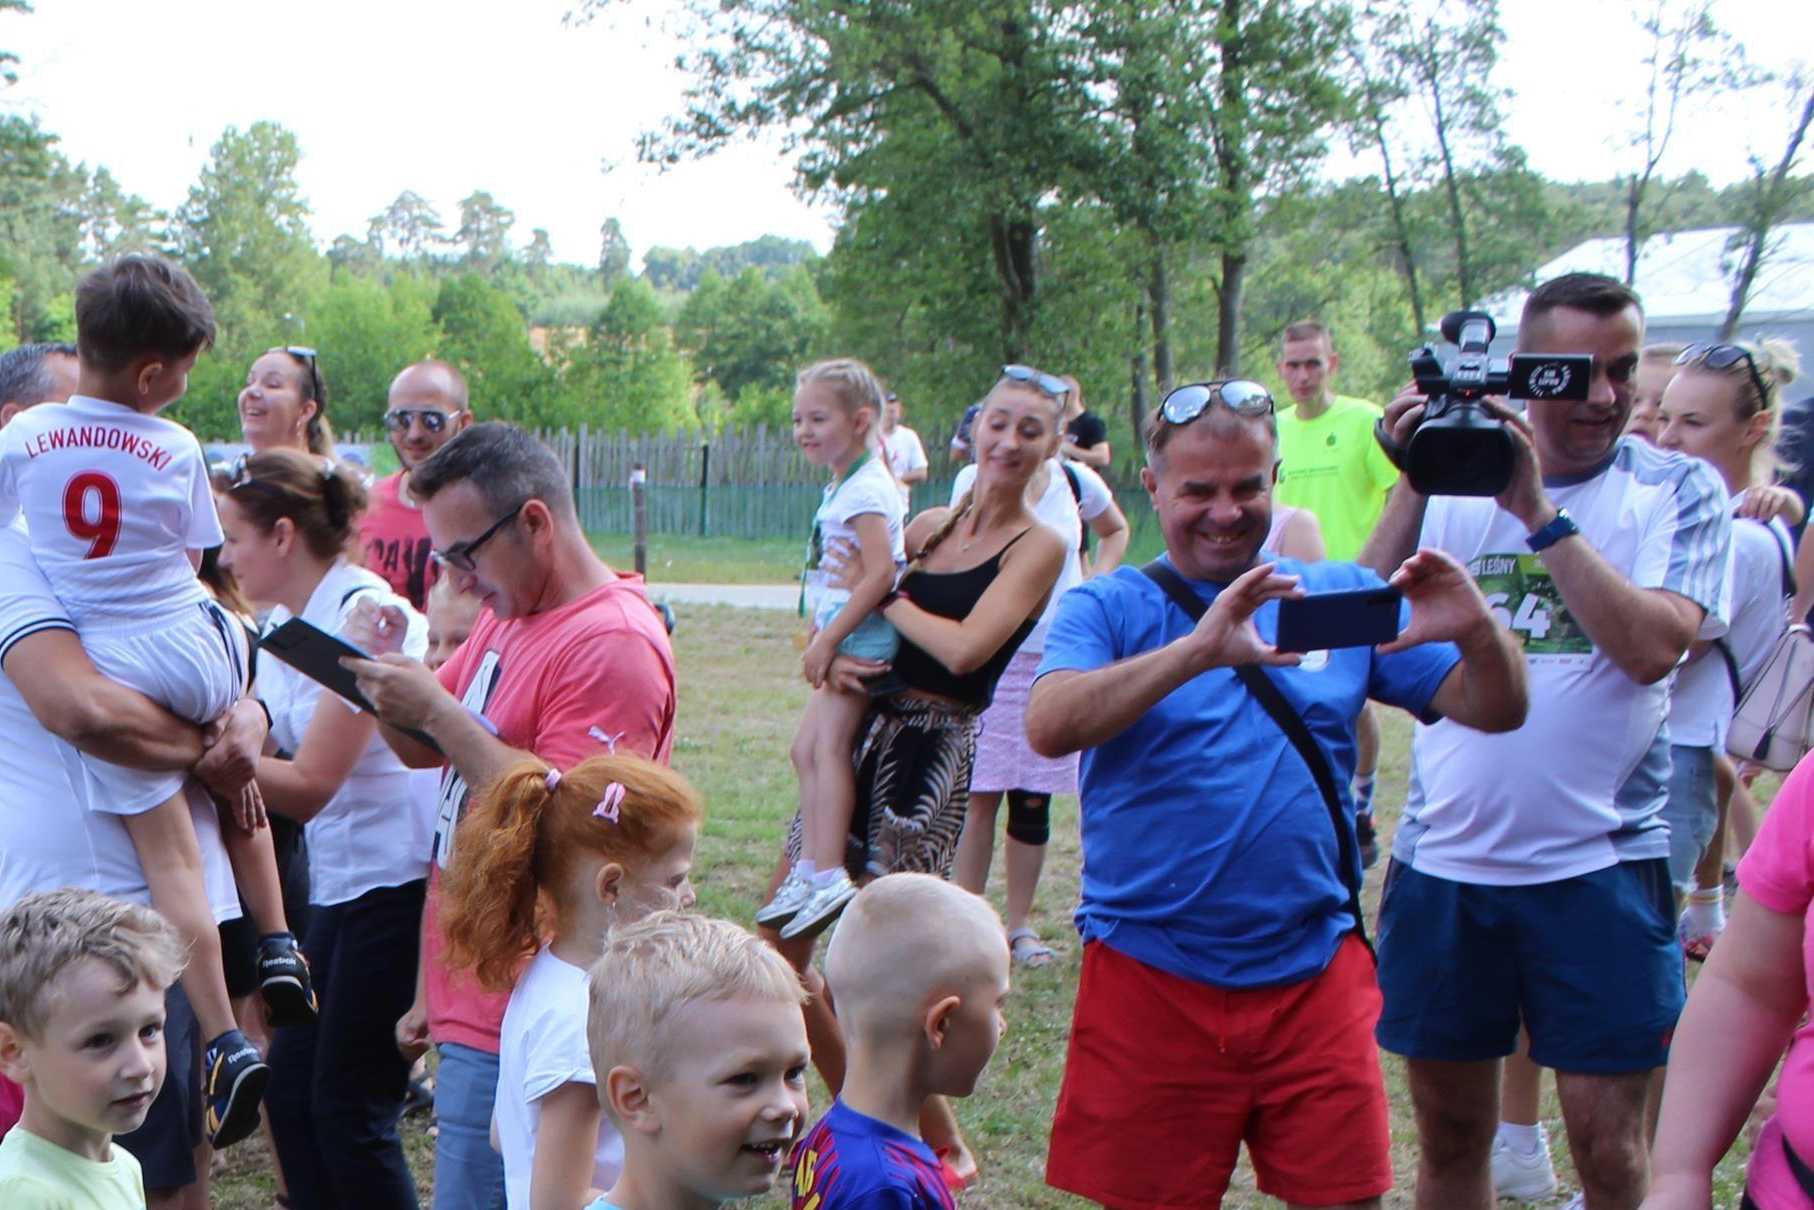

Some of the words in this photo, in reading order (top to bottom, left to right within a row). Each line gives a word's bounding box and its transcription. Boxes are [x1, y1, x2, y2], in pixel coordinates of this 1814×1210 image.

[24, 426, 173, 472] LEWANDOWSKI
[62, 469, 122, 560] 9
[1481, 555, 1516, 576] LEŚNY
